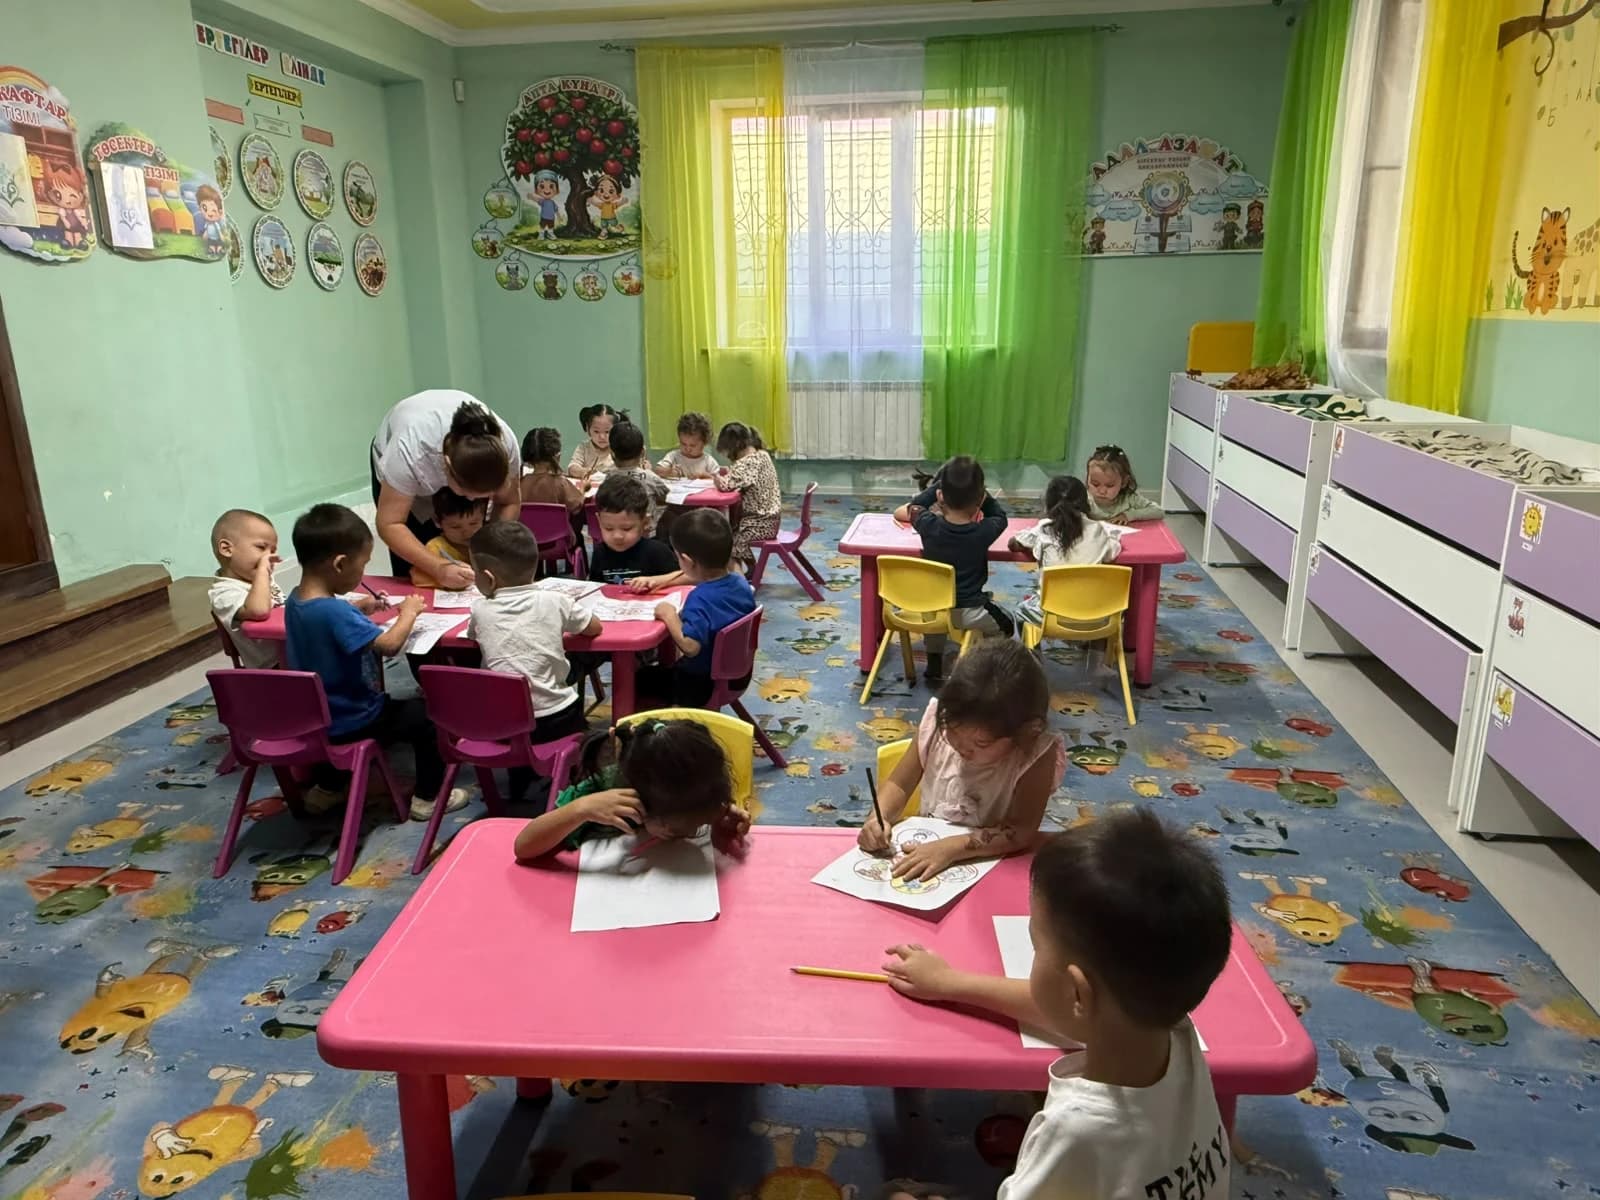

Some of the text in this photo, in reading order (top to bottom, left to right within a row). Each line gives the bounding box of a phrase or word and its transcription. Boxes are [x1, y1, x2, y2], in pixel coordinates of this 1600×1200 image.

[524, 83, 557, 104] АПТА
[3, 105, 43, 126] ТІЗІМІ
[94, 137, 154, 161] ТӨСЕКТЕР
[145, 165, 178, 181] ТІЗІМІ
